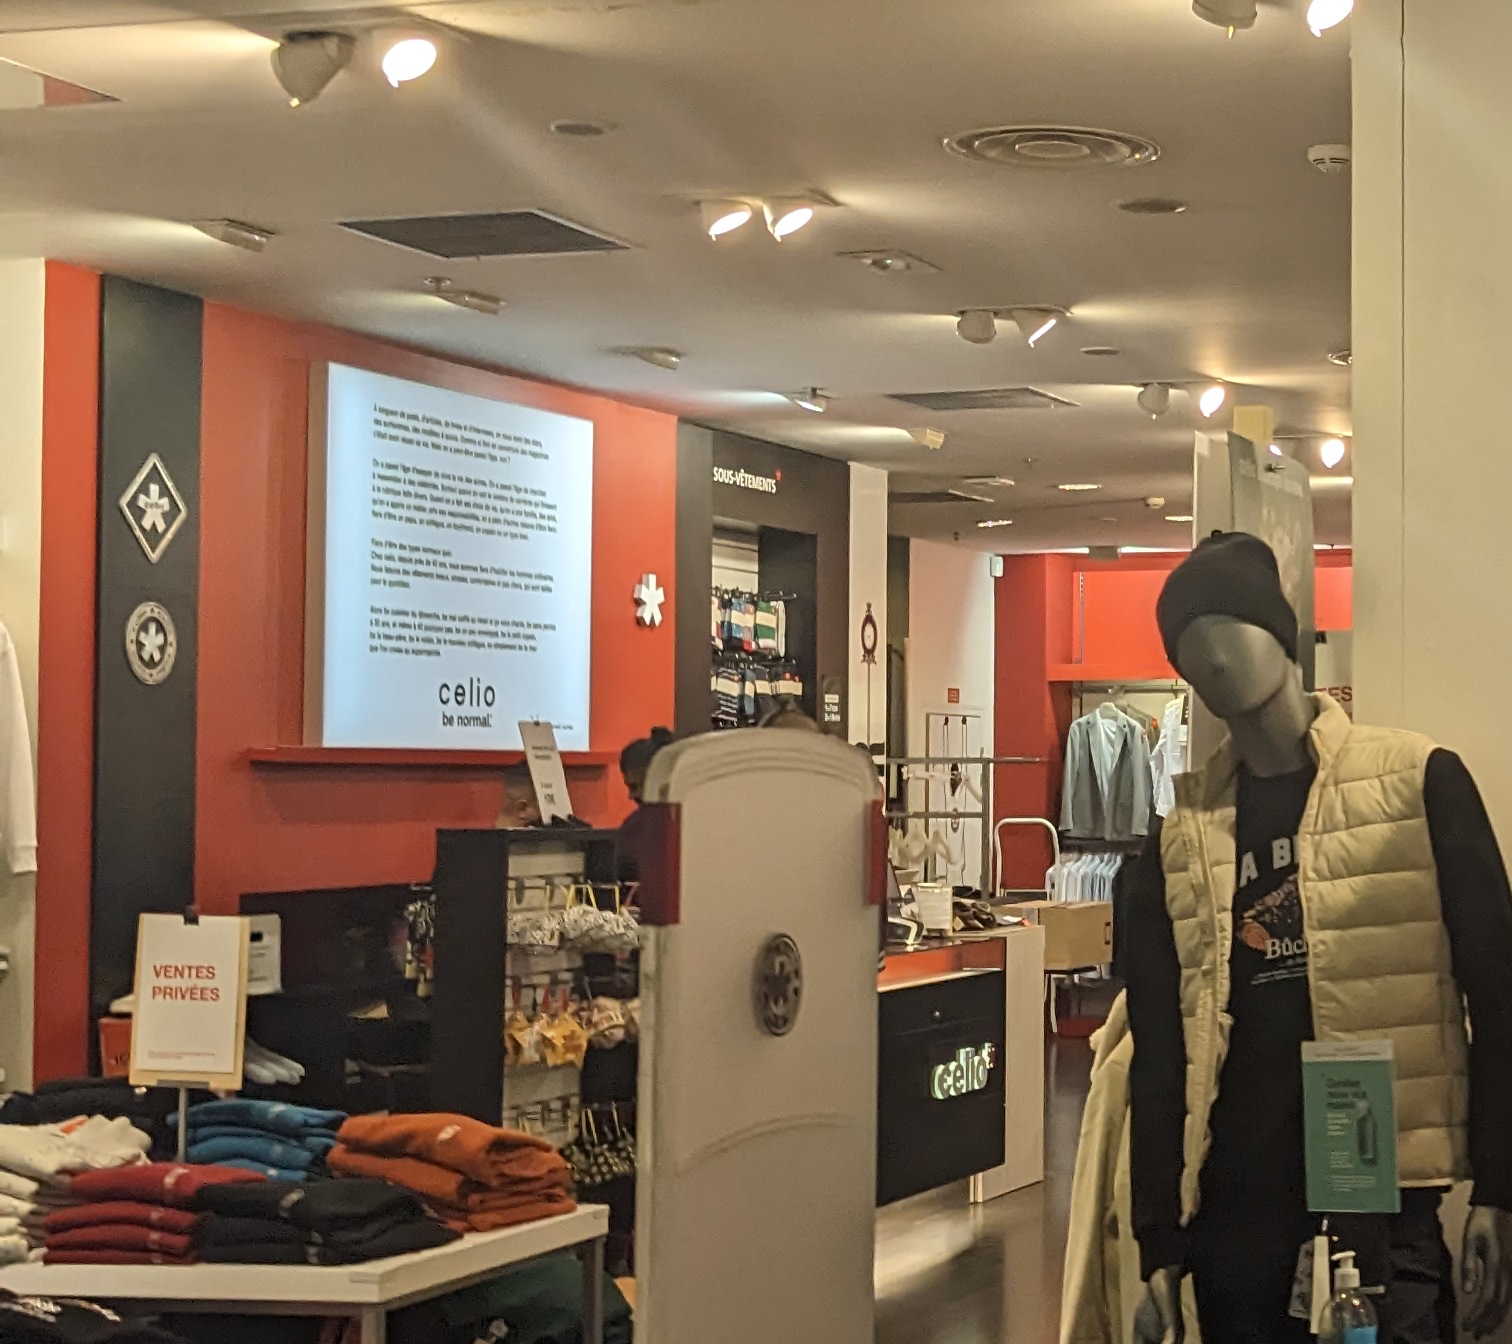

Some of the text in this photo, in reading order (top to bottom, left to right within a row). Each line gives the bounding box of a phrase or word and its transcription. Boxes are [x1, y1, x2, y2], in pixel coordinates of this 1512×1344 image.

[713, 466, 777, 493] SOUS-VÊTEMENTS
[439, 676, 496, 707] celio
[442, 711, 455, 727] be
[153, 964, 216, 980] VENTES
[151, 984, 221, 1001] PRIVÉES
